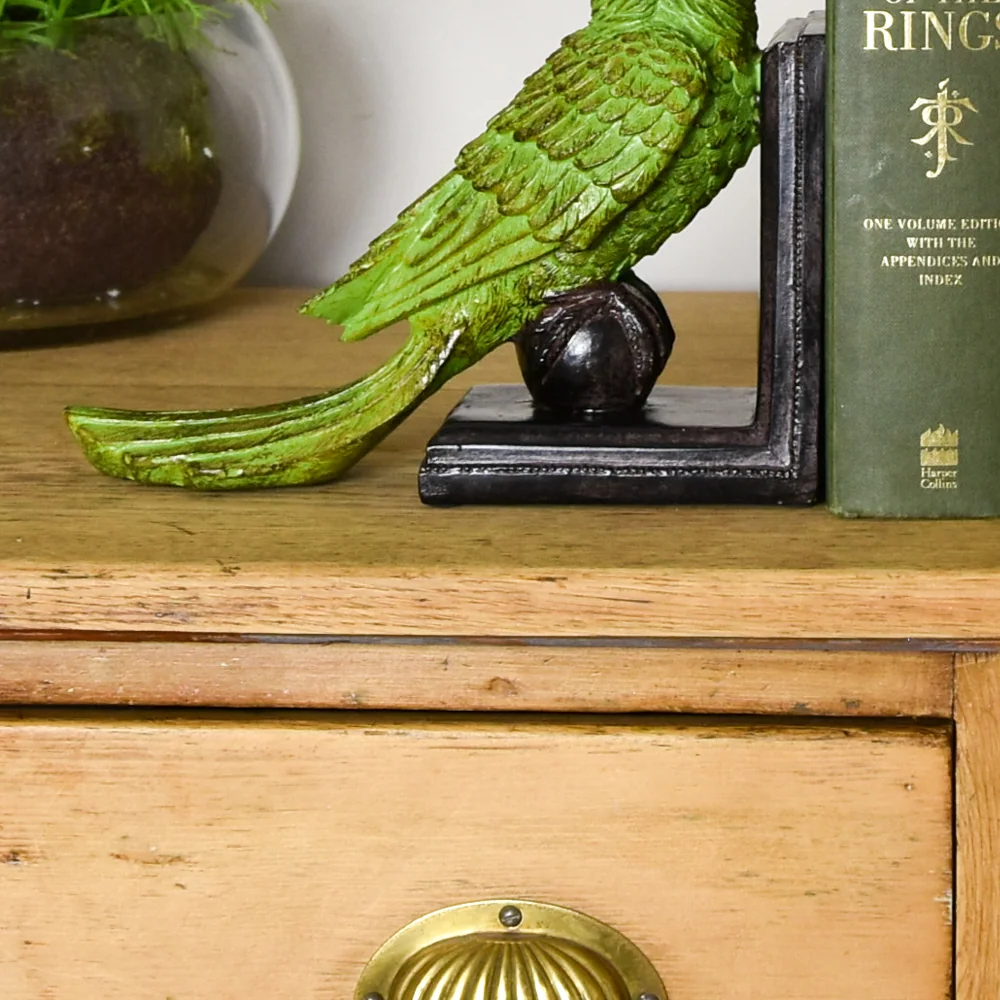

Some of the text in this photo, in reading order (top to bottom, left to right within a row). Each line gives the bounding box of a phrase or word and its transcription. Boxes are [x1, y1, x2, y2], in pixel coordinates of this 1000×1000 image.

[863, 218, 893, 230] ONE
[897, 217, 957, 230] VOLUME
[906, 236, 976, 249] WITH THE
[880, 255, 968, 268] APPENDICES
[918, 274, 963, 287] INDEX
[920, 467, 957, 480] Harper
[920, 478, 957, 490] Collins
